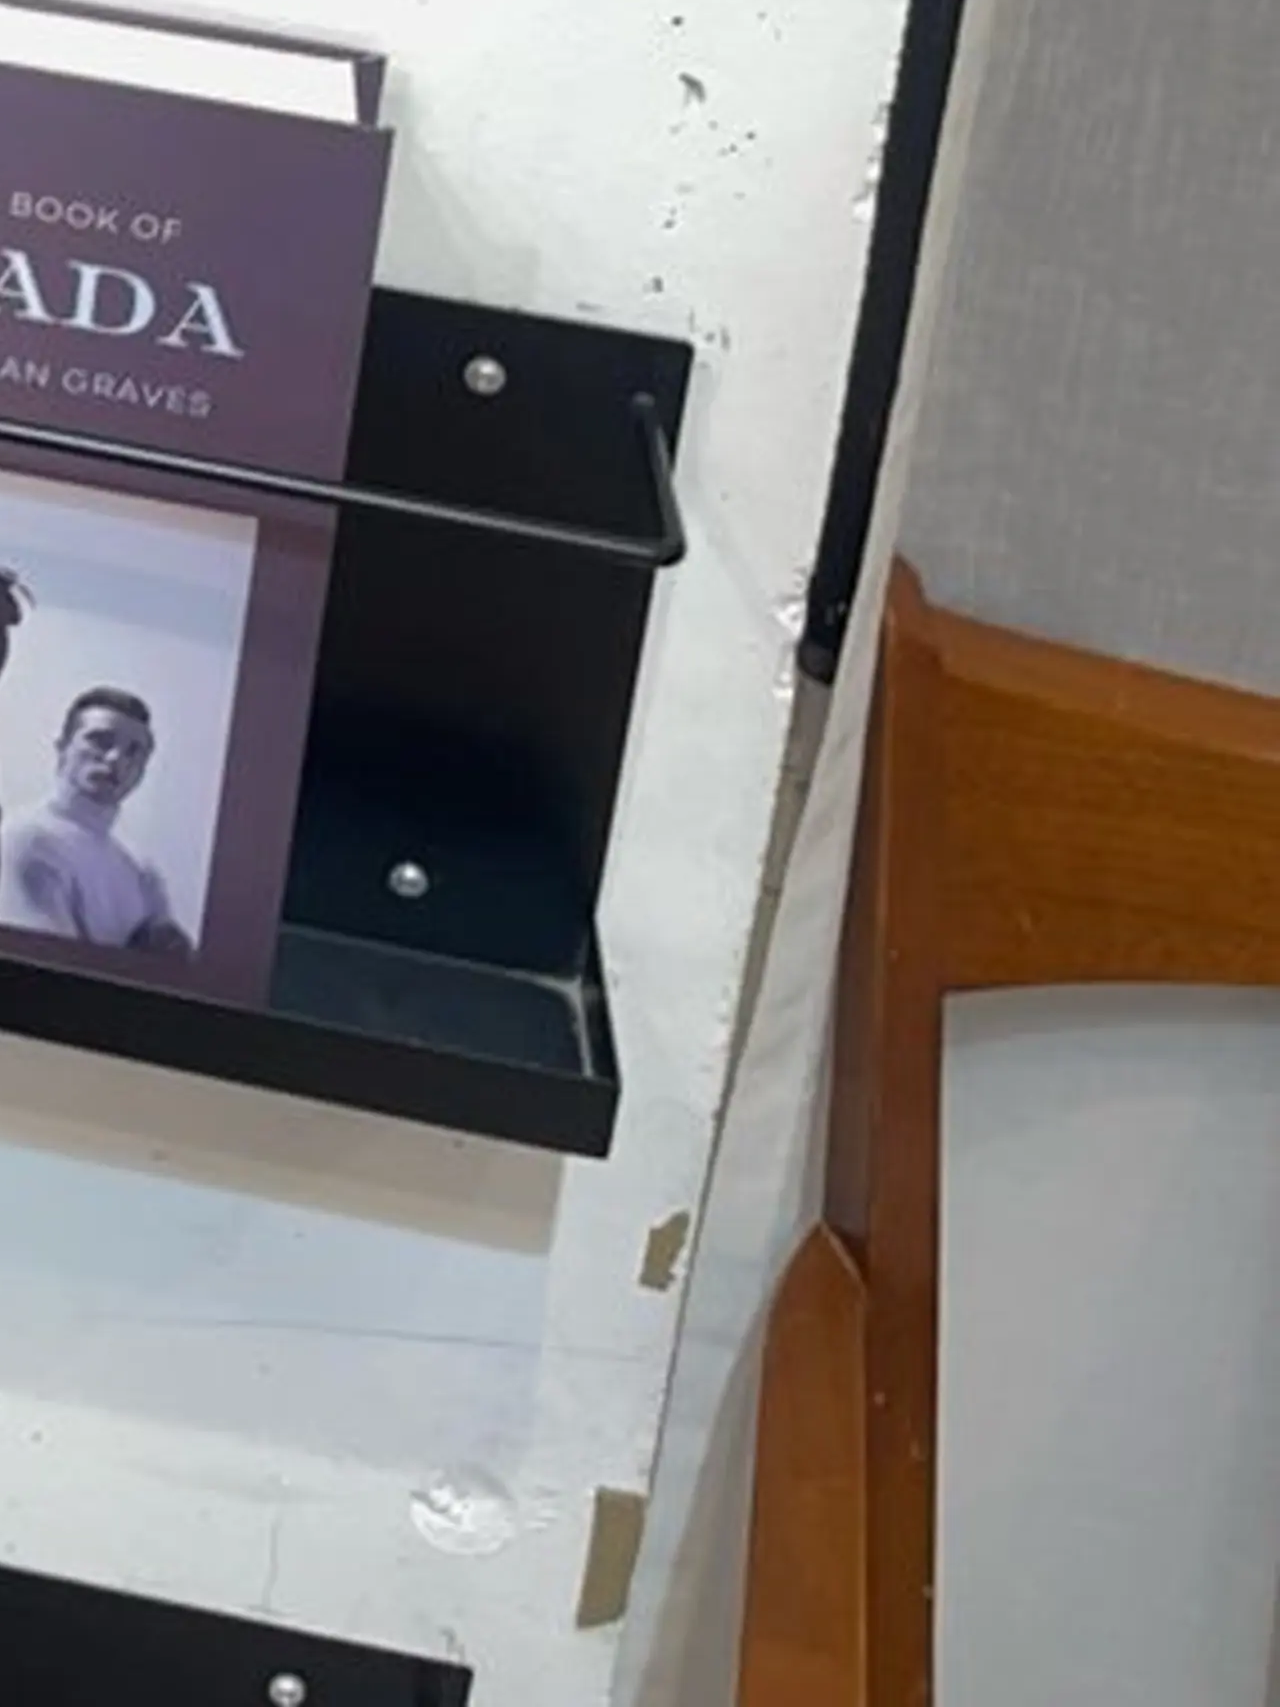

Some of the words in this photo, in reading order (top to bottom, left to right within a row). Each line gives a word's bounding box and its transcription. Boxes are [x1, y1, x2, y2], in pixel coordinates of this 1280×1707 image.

[10, 190, 119, 234] BOOK
[131, 212, 183, 244] OF
[61, 366, 212, 420] GRAVES
